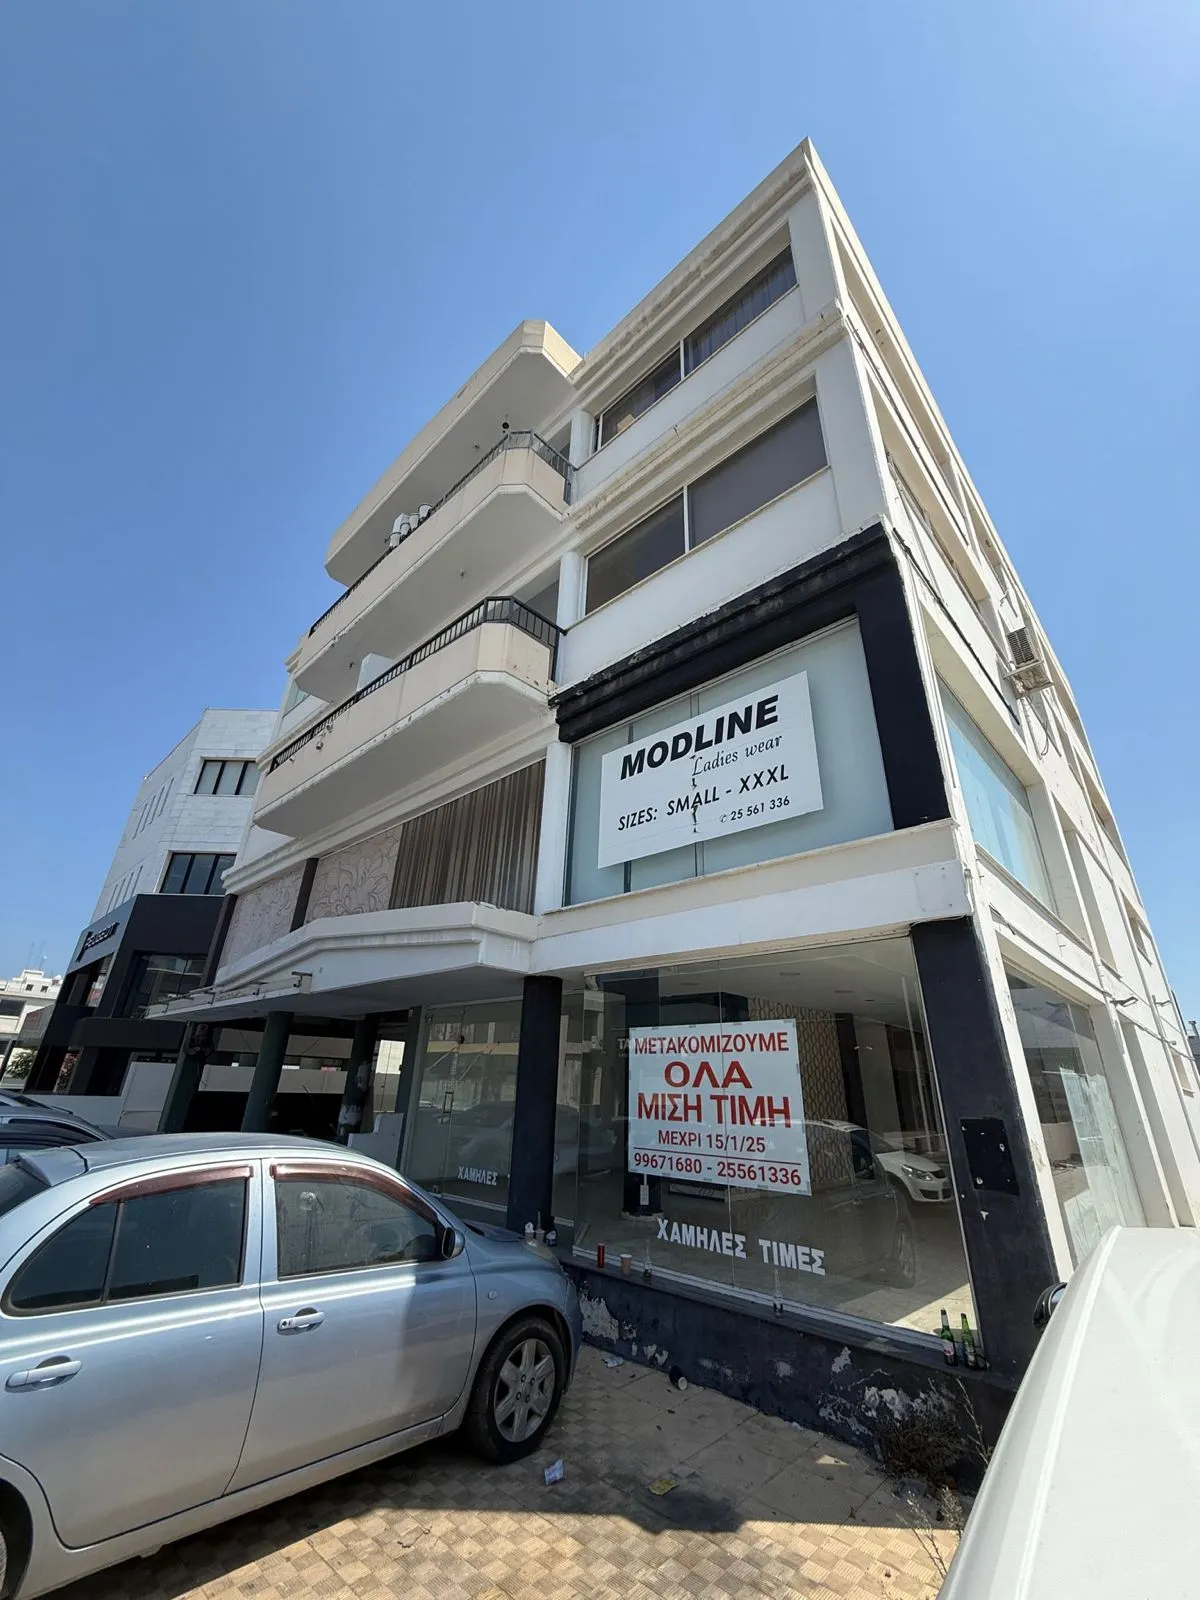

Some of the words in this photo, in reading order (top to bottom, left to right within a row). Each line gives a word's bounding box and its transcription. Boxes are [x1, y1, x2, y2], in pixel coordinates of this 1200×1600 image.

[620, 695, 779, 781] MODLINE
[691, 750, 738, 776] Ladies
[745, 735, 783, 758] wear
[618, 808, 658, 831] SIZES:
[666, 786, 720, 816] SMALL
[739, 764, 789, 794] XXXL
[730, 808, 743, 821] 25
[747, 802, 765, 817] 561
[769, 796, 790, 810] 336
[634, 1032, 789, 1055] ΜΕΤΑΚΟΜΙΖΟΥΜΕ
[664, 1060, 752, 1089] ΟΛΑ
[637, 1092, 702, 1123] ΜΙΣΗ
[710, 1095, 791, 1128] ΤΙΜΗ
[658, 1129, 701, 1148] ΜΕΧΡΙ
[706, 1134, 766, 1153] 15/1/25
[457, 1166, 499, 1185] ΧΑΜΗΛΕΣ
[634, 1152, 701, 1174] 99671680
[717, 1161, 801, 1186] 25561336
[656, 1218, 747, 1259] ΧΑΜΗΛΕΣ
[758, 1238, 826, 1276] ΤΙΜΕΣ
